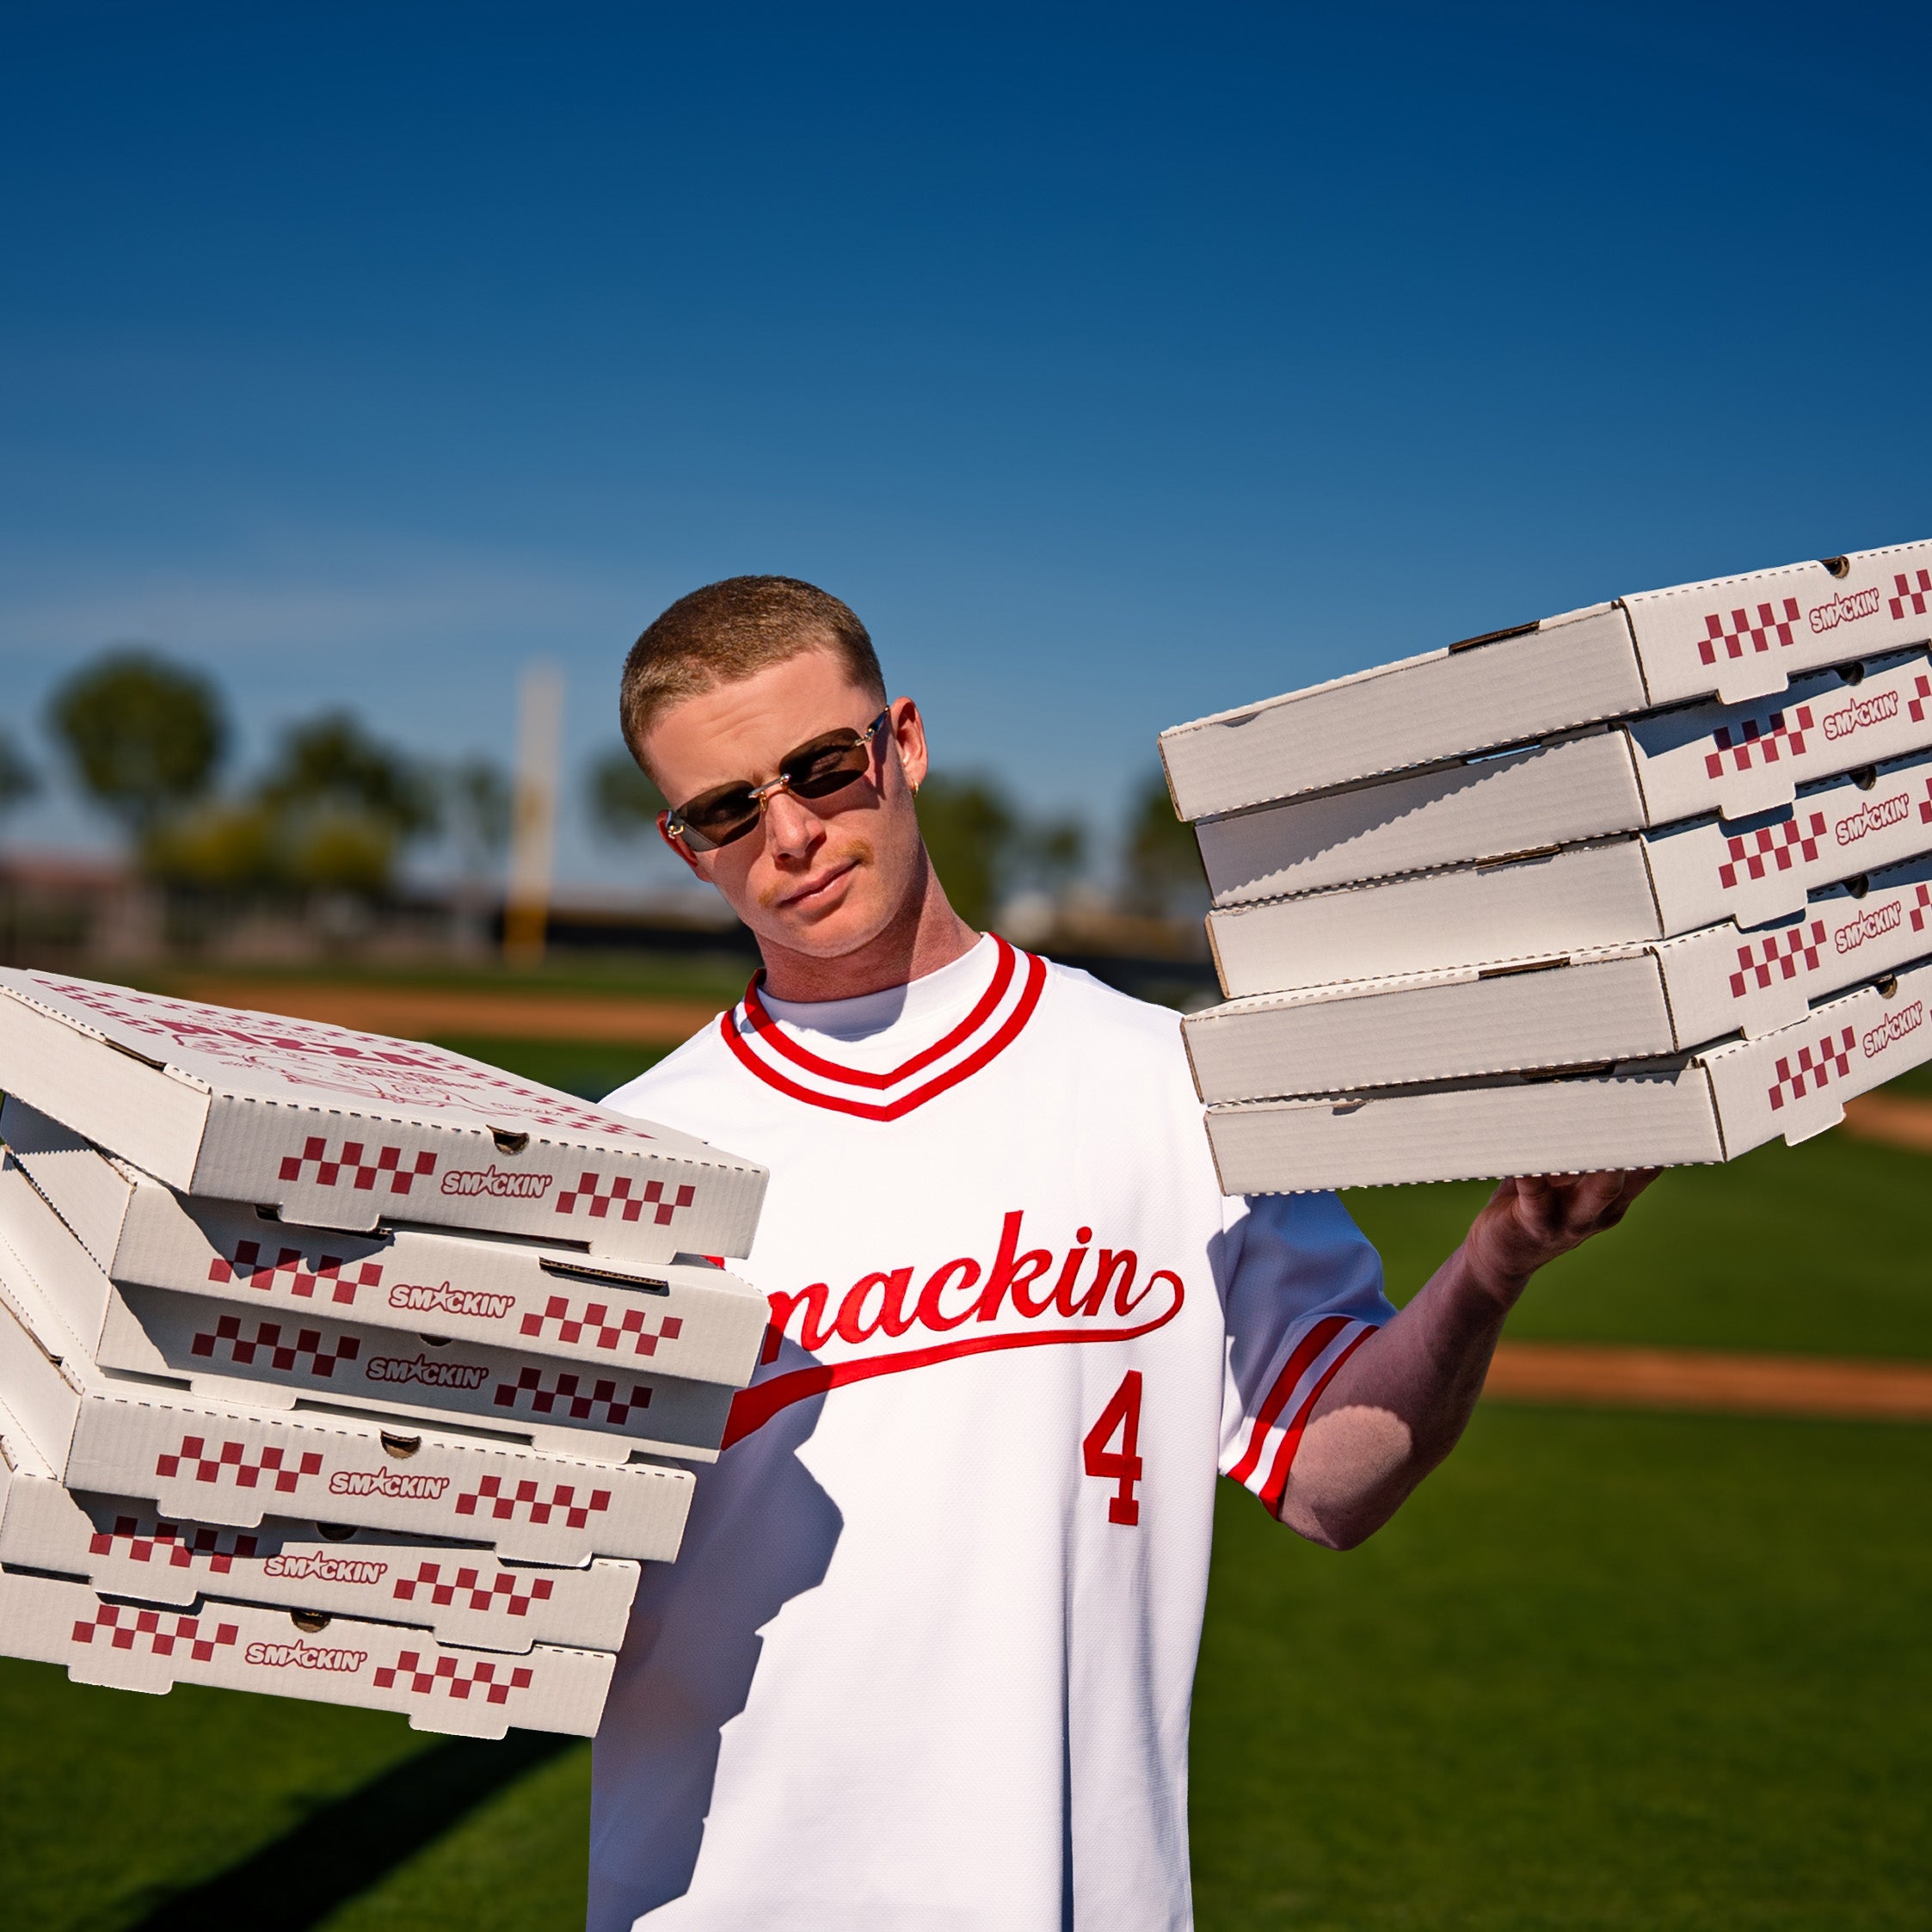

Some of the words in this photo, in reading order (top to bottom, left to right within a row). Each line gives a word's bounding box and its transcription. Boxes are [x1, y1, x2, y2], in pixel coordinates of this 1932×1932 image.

[150, 1018, 444, 1071] PIZZA
[701, 1210, 1184, 1366] mackin
[1084, 1370, 1142, 1525] 4
